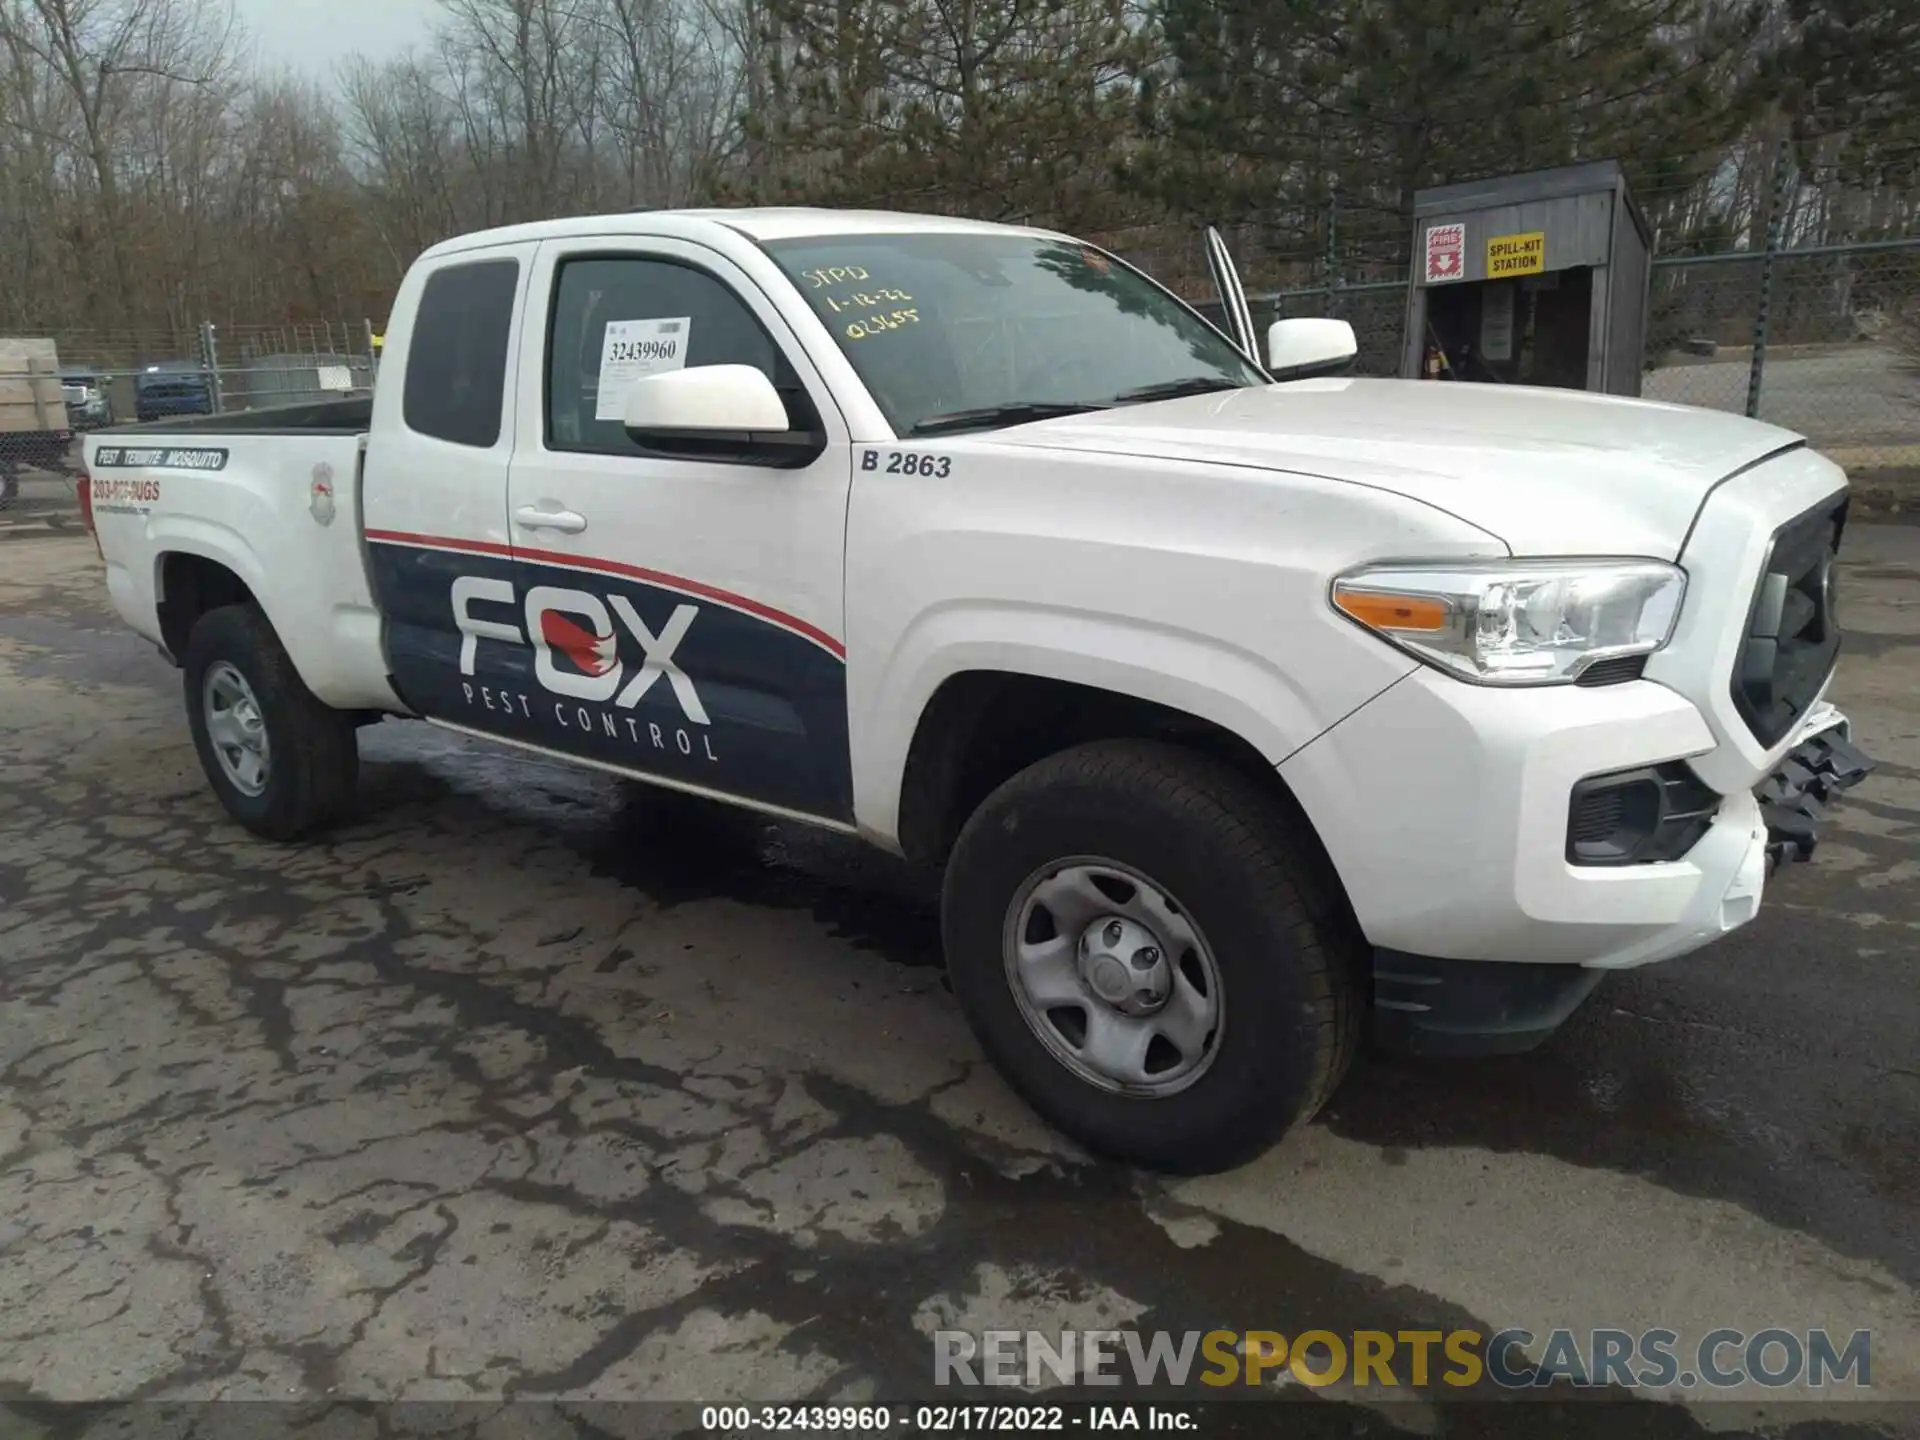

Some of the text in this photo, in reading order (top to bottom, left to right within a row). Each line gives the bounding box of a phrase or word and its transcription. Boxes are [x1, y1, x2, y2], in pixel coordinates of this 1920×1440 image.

[1432, 232, 1459, 245] FIRE
[1489, 238, 1541, 257] SPILL-KIT
[1493, 255, 1537, 271] STATION
[609, 339, 676, 361] 32439960
[861, 450, 952, 478] B 2863
[451, 576, 711, 725] FOX
[462, 682, 718, 761] PEST CONTROL
